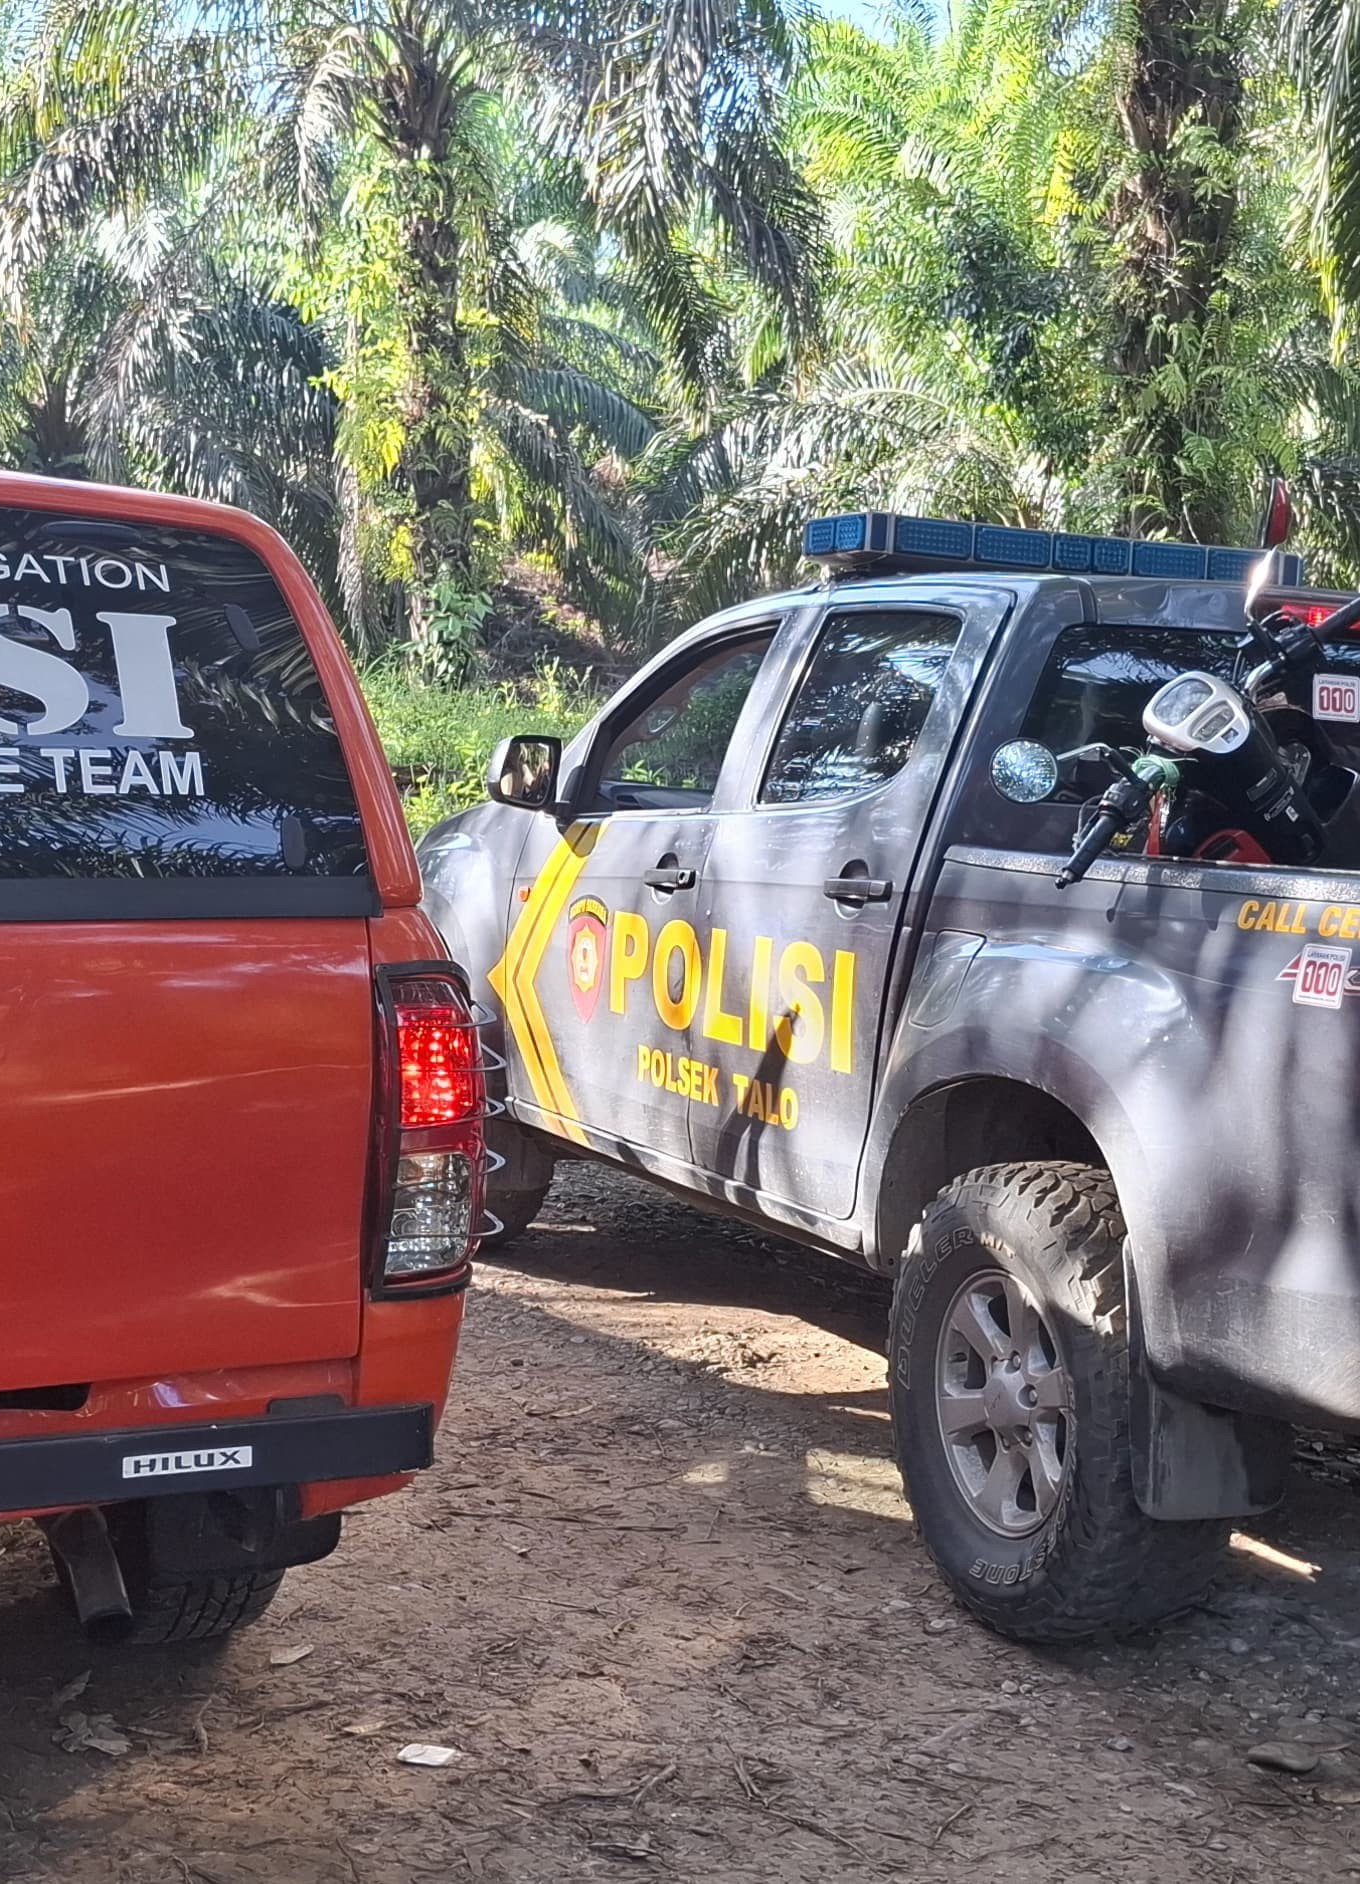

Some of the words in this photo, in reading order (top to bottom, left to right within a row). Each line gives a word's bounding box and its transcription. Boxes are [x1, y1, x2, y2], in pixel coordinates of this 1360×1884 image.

[1319, 687, 1355, 712] 110
[39, 747, 206, 797] TEAM
[1237, 900, 1308, 934] CALL
[609, 911, 857, 1074] POLISI
[1303, 962, 1341, 995] 110
[637, 1044, 720, 1107] POLSEK
[732, 1072, 800, 1131] TALO
[895, 1225, 975, 1391] DUELER
[133, 1449, 242, 1475] HILUX
